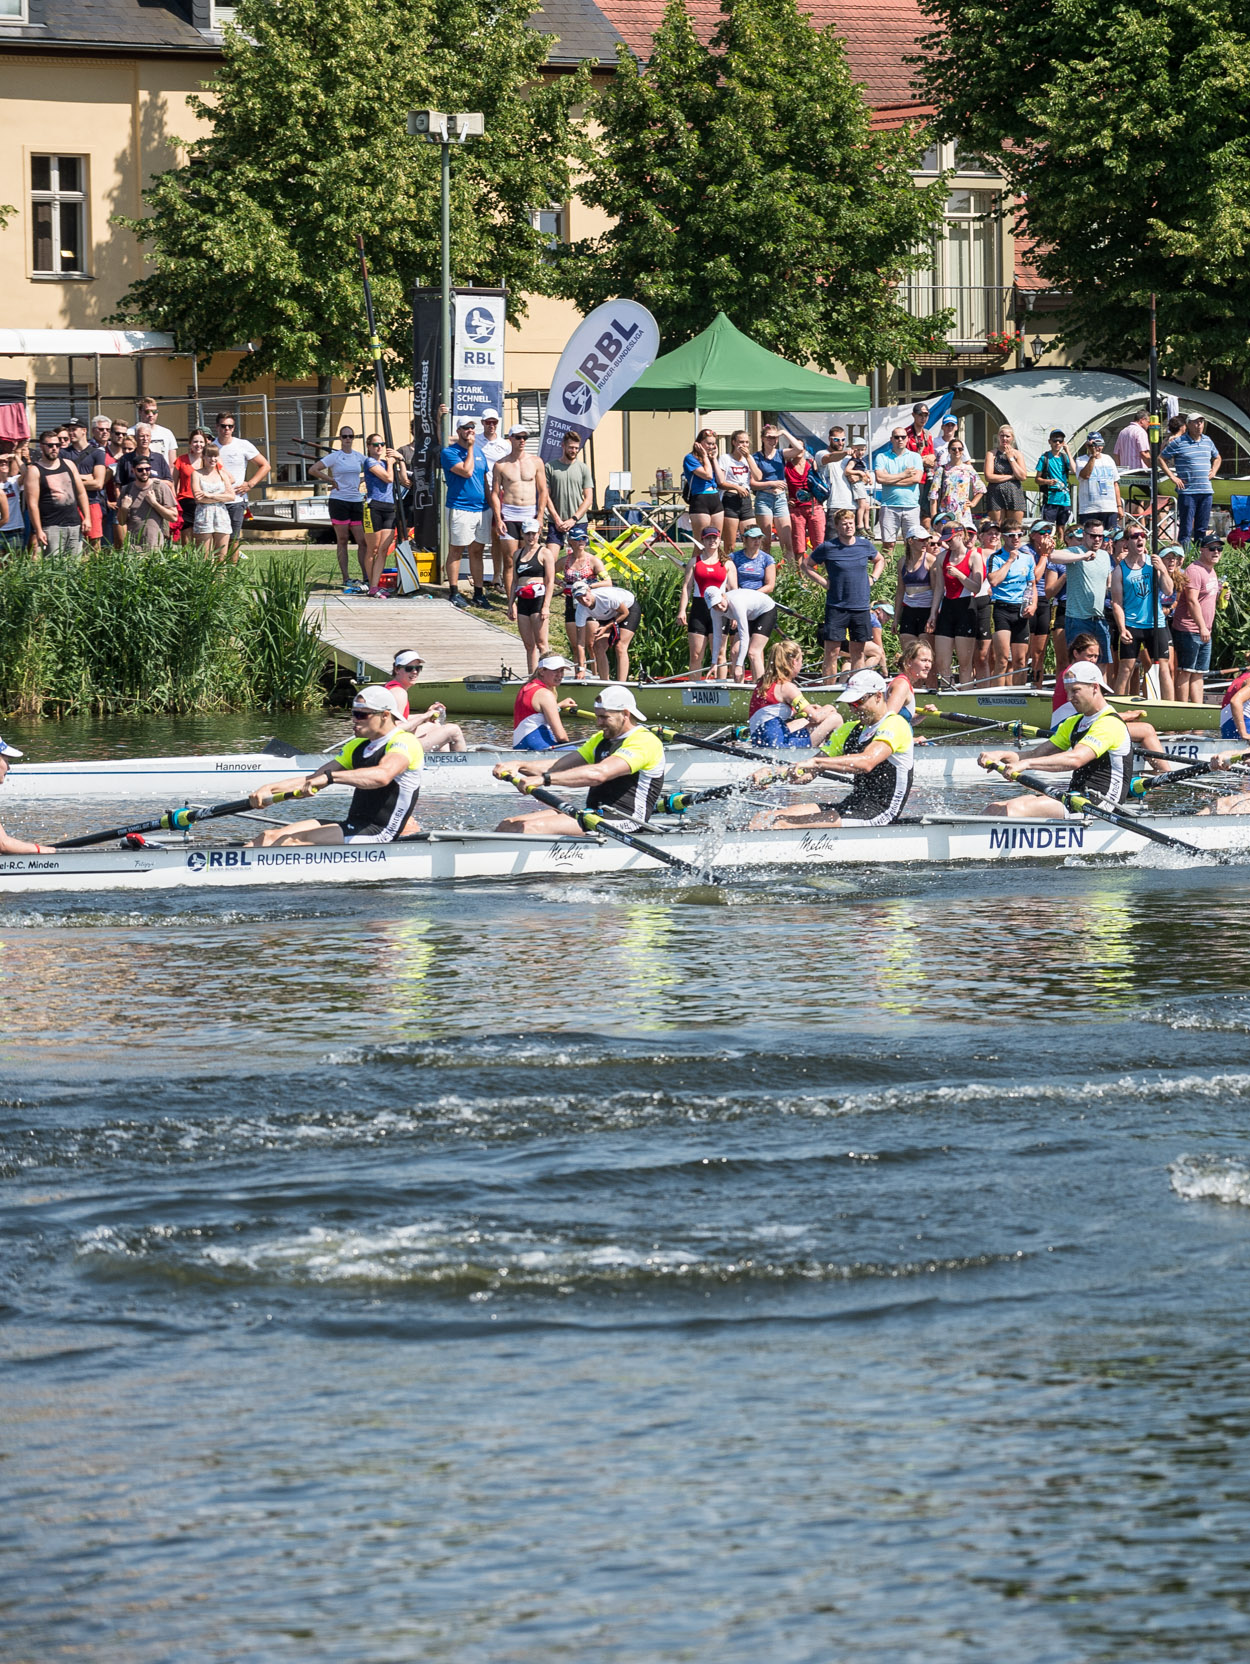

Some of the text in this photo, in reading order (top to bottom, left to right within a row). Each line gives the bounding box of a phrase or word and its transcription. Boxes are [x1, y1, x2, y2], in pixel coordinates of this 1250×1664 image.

[464, 352, 495, 365] RBL
[579, 319, 639, 384] RBL
[598, 330, 644, 390] RUDER-BUNDESLIGA
[420, 360, 431, 434] Broadcast
[456, 386, 484, 394] STARK.
[456, 403, 476, 411] GUT.
[418, 436, 432, 462] Live
[692, 692, 720, 704] HANAU
[216, 762, 261, 772] Hannover
[800, 831, 834, 851] Melitta
[990, 828, 1084, 849] MINDEN
[210, 850, 386, 866] RBL RUDER-BUNDESLIGA
[545, 844, 584, 860] Melitta
[28, 860, 60, 868] Minden
